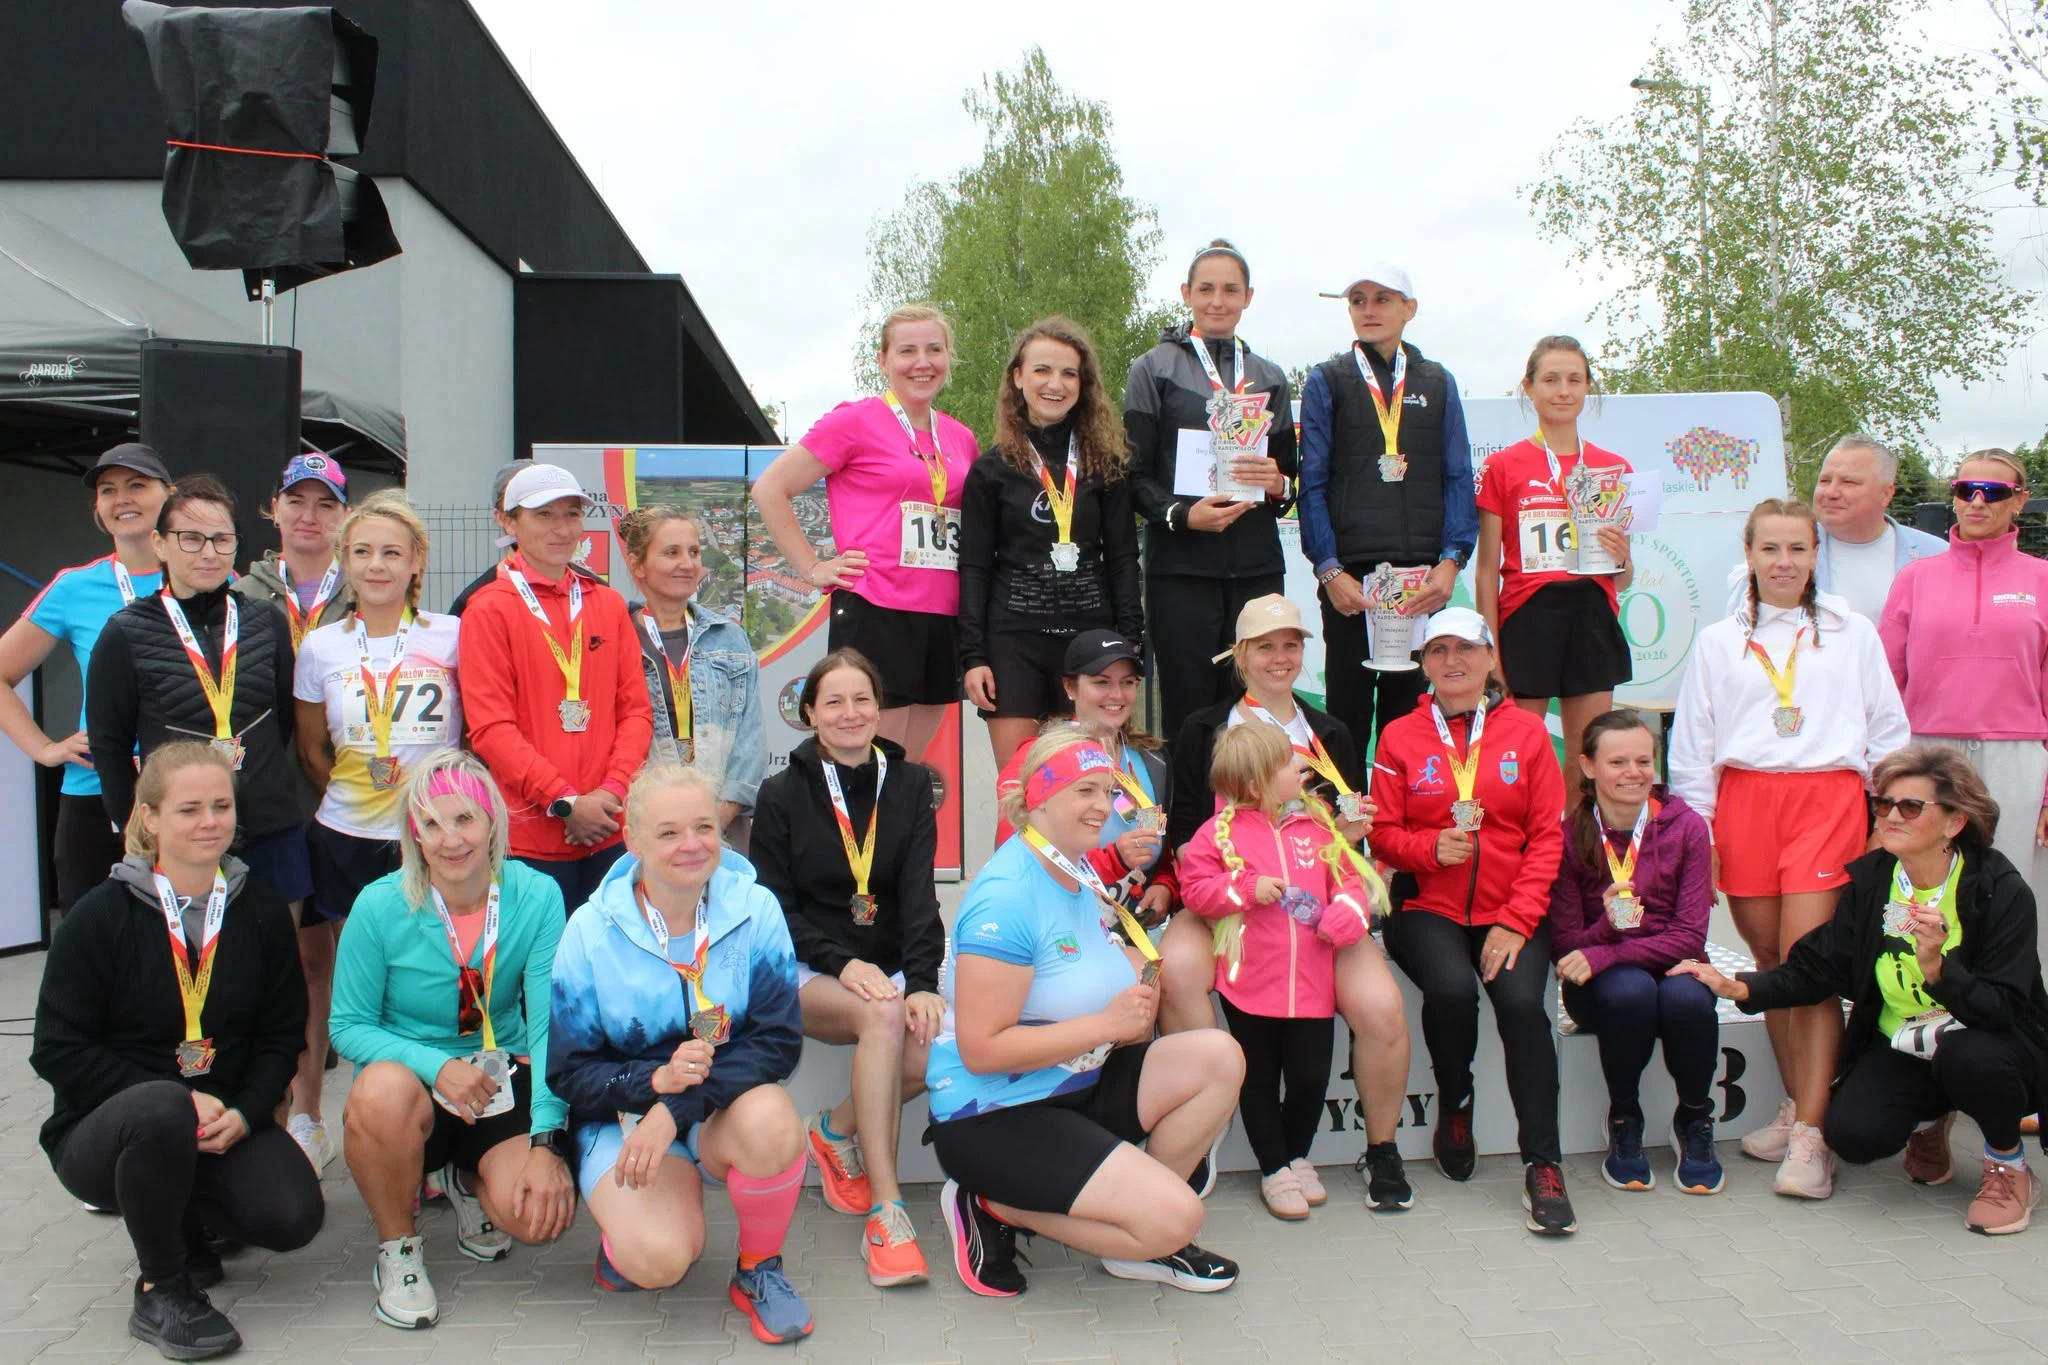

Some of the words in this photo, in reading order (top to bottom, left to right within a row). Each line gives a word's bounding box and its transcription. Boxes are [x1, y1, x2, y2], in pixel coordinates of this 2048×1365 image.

[29, 363, 73, 376] GARDEN
[1662, 480, 1695, 493] laskie
[586, 505, 625, 518] ZYN
[911, 516, 961, 554] 183
[1530, 521, 1572, 553] 16
[1635, 650, 1667, 661] 2026
[356, 683, 444, 722] 172
